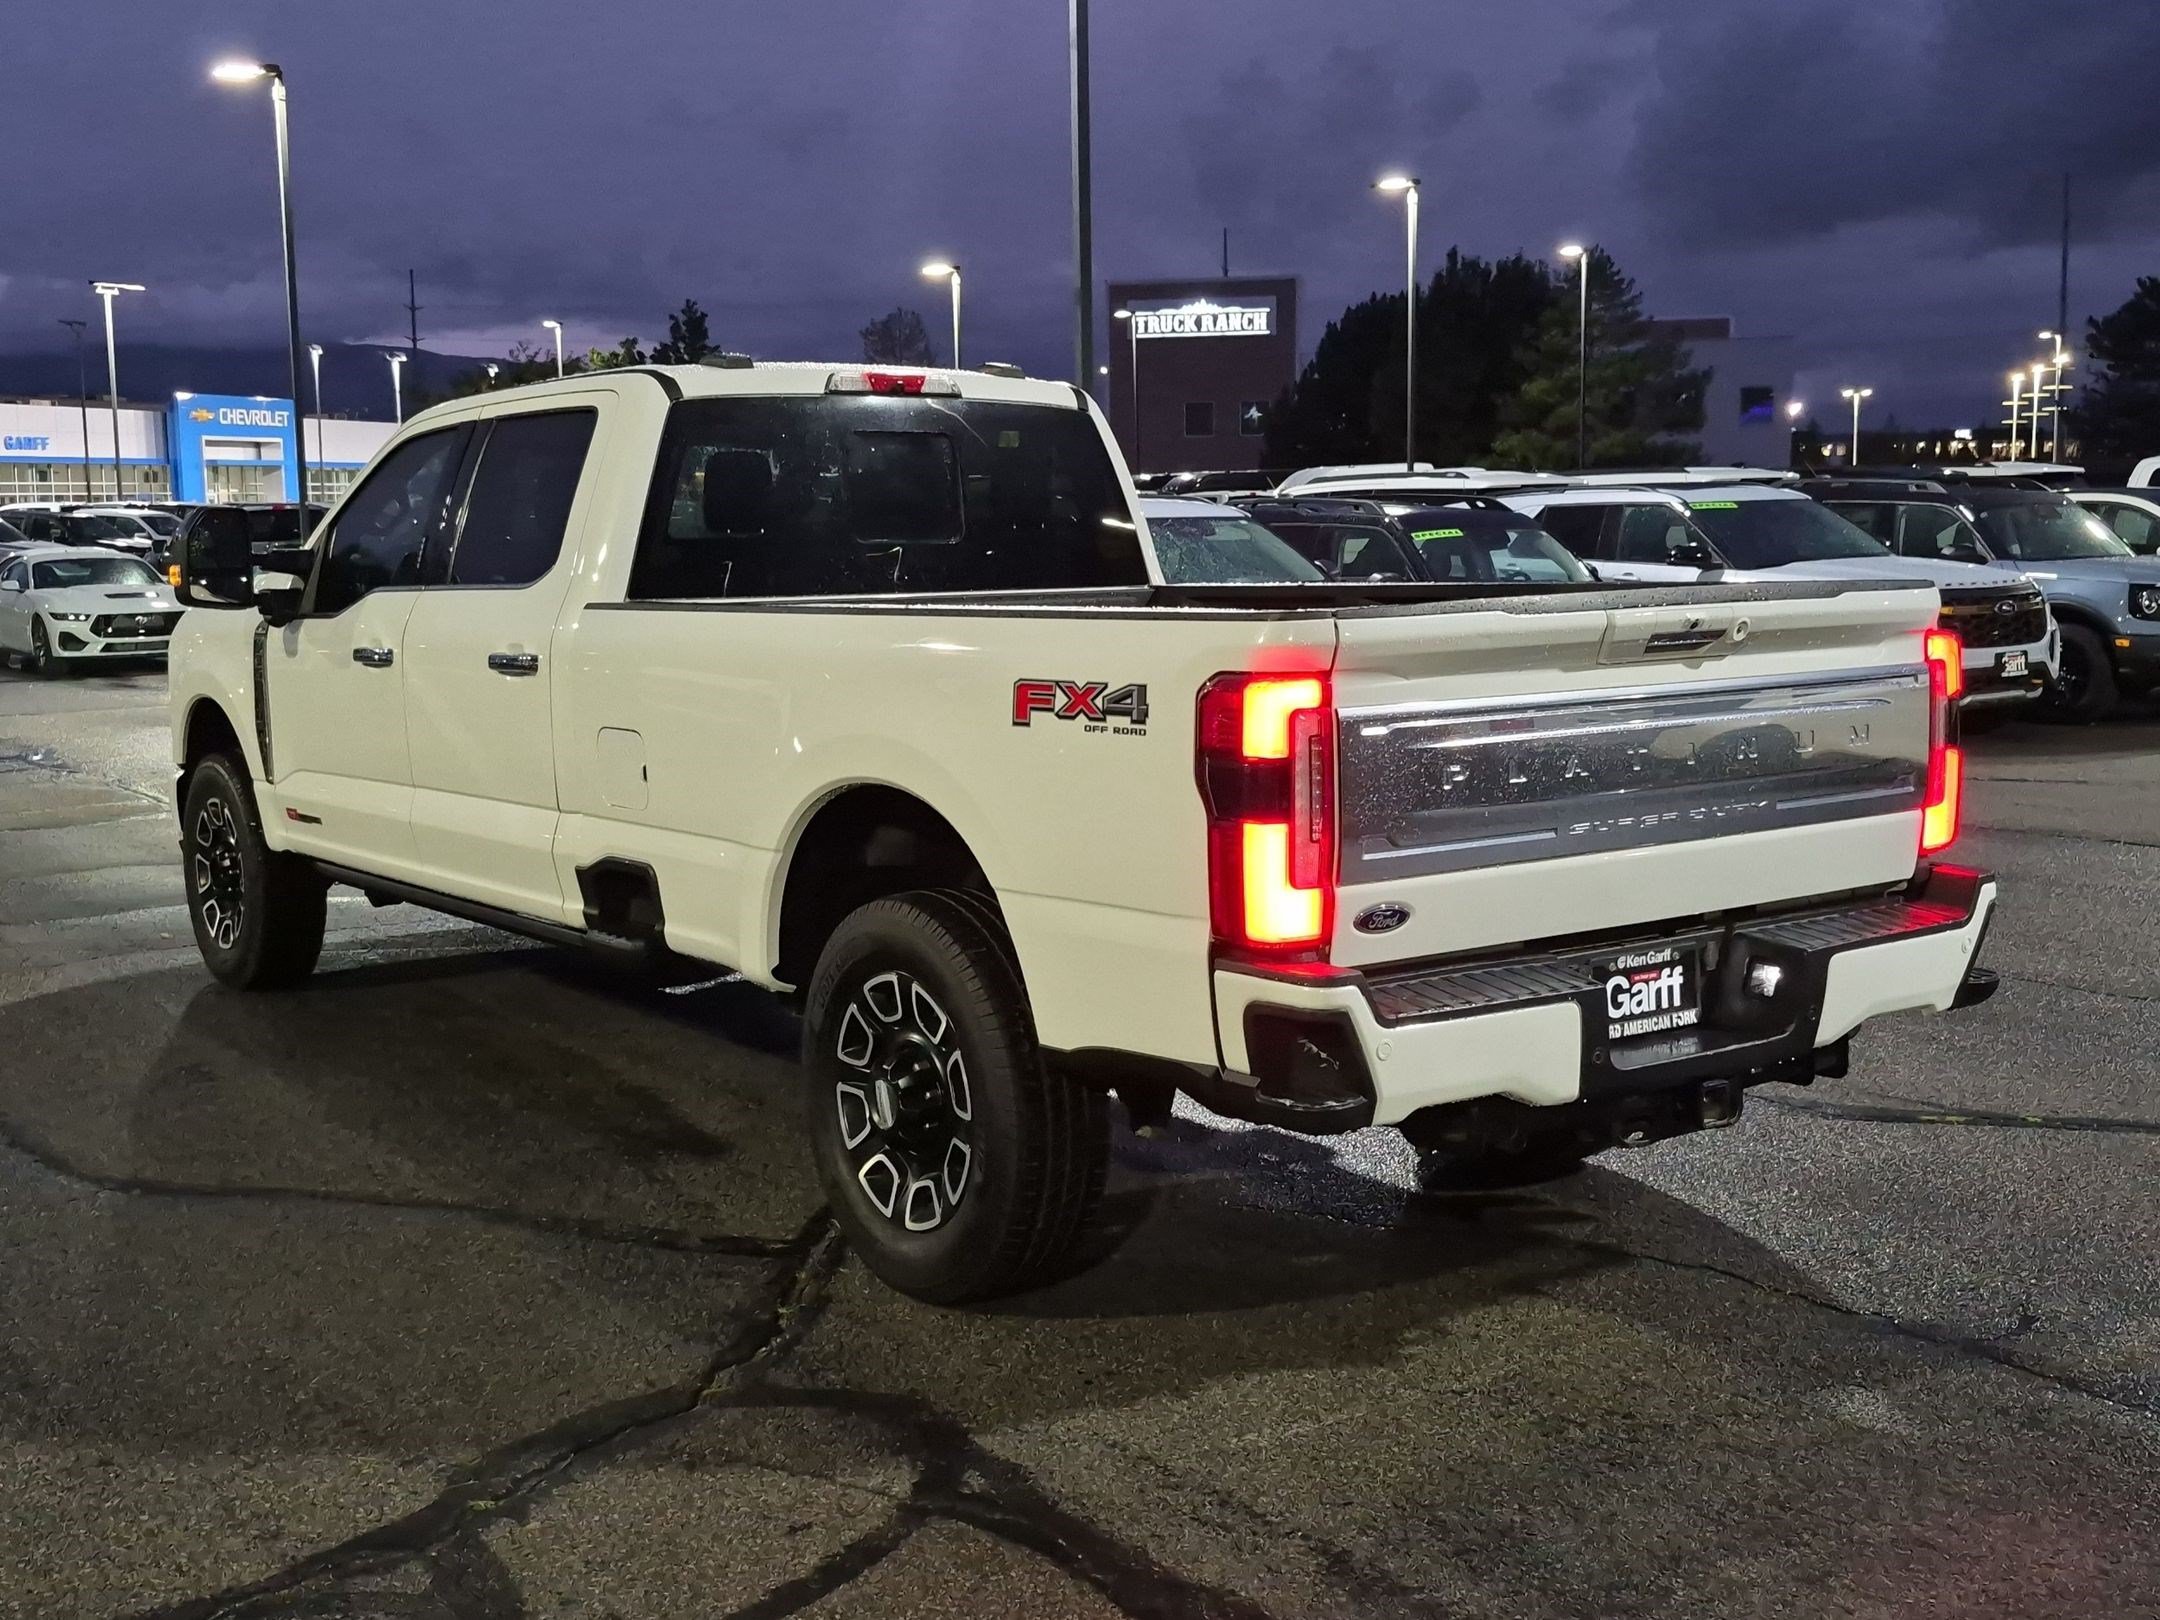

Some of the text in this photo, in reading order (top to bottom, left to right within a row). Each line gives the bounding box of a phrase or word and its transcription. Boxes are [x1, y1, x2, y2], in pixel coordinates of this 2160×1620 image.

[1136, 311, 1268, 334] TRUCK RANCH
[219, 407, 290, 427] CHEVROLET
[3, 435, 50, 451] GARFF
[1413, 529, 1460, 539] SPECIAL
[1012, 678, 1149, 727] FX4
[1084, 724, 1147, 737] OFF ROAD
[1442, 723, 1870, 790] PLATINUM
[1569, 811, 1680, 834] SUPER
[1368, 911, 1400, 929] Ford
[1606, 965, 1683, 1019] Garff
[1608, 1009, 1697, 1039] RD AMERICAN FORK
